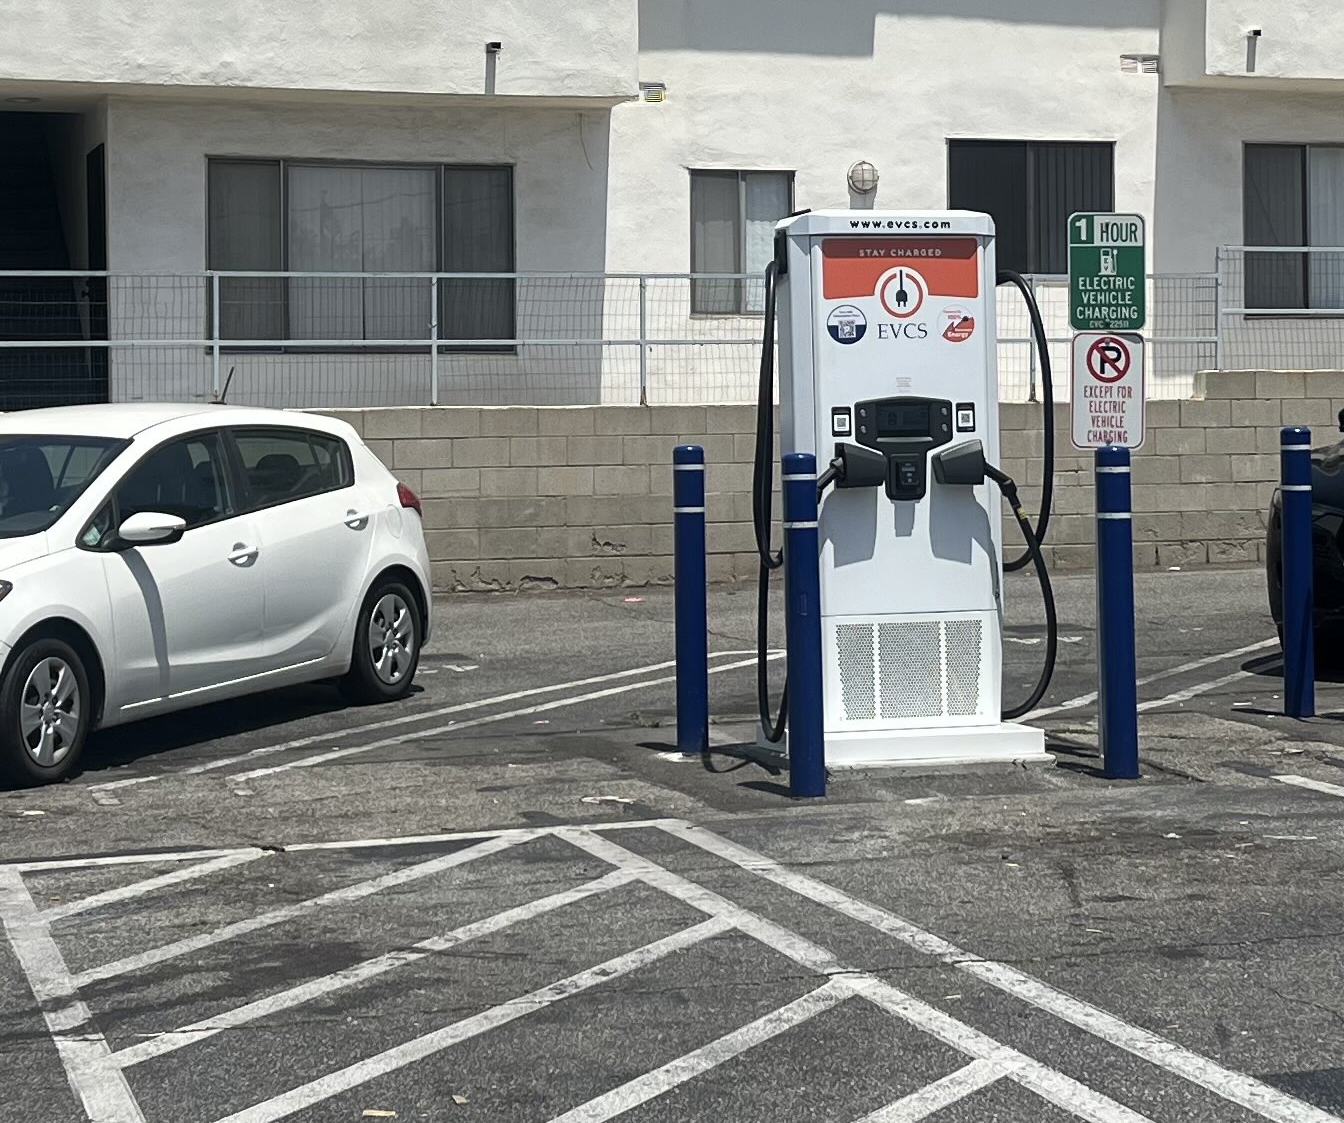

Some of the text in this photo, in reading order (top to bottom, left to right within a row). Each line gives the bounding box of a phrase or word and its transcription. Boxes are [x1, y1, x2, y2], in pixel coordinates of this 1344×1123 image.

[849, 219, 951, 229] www.evcs.com
[1075, 218, 1138, 243] 1 HOUR
[859, 248, 942, 257] STAY CHARGED
[1078, 276, 1136, 290] ELECTRIC
[1081, 291, 1133, 305] VEHICLE
[1076, 306, 1138, 319] CHARGING
[877, 323, 928, 340] EVCS
[1083, 385, 1133, 399] EXCEPT FOR
[1088, 400, 1126, 414] ELECTRIC
[1090, 415, 1125, 429] VEHICLE
[1087, 430, 1128, 443] CHARGING
